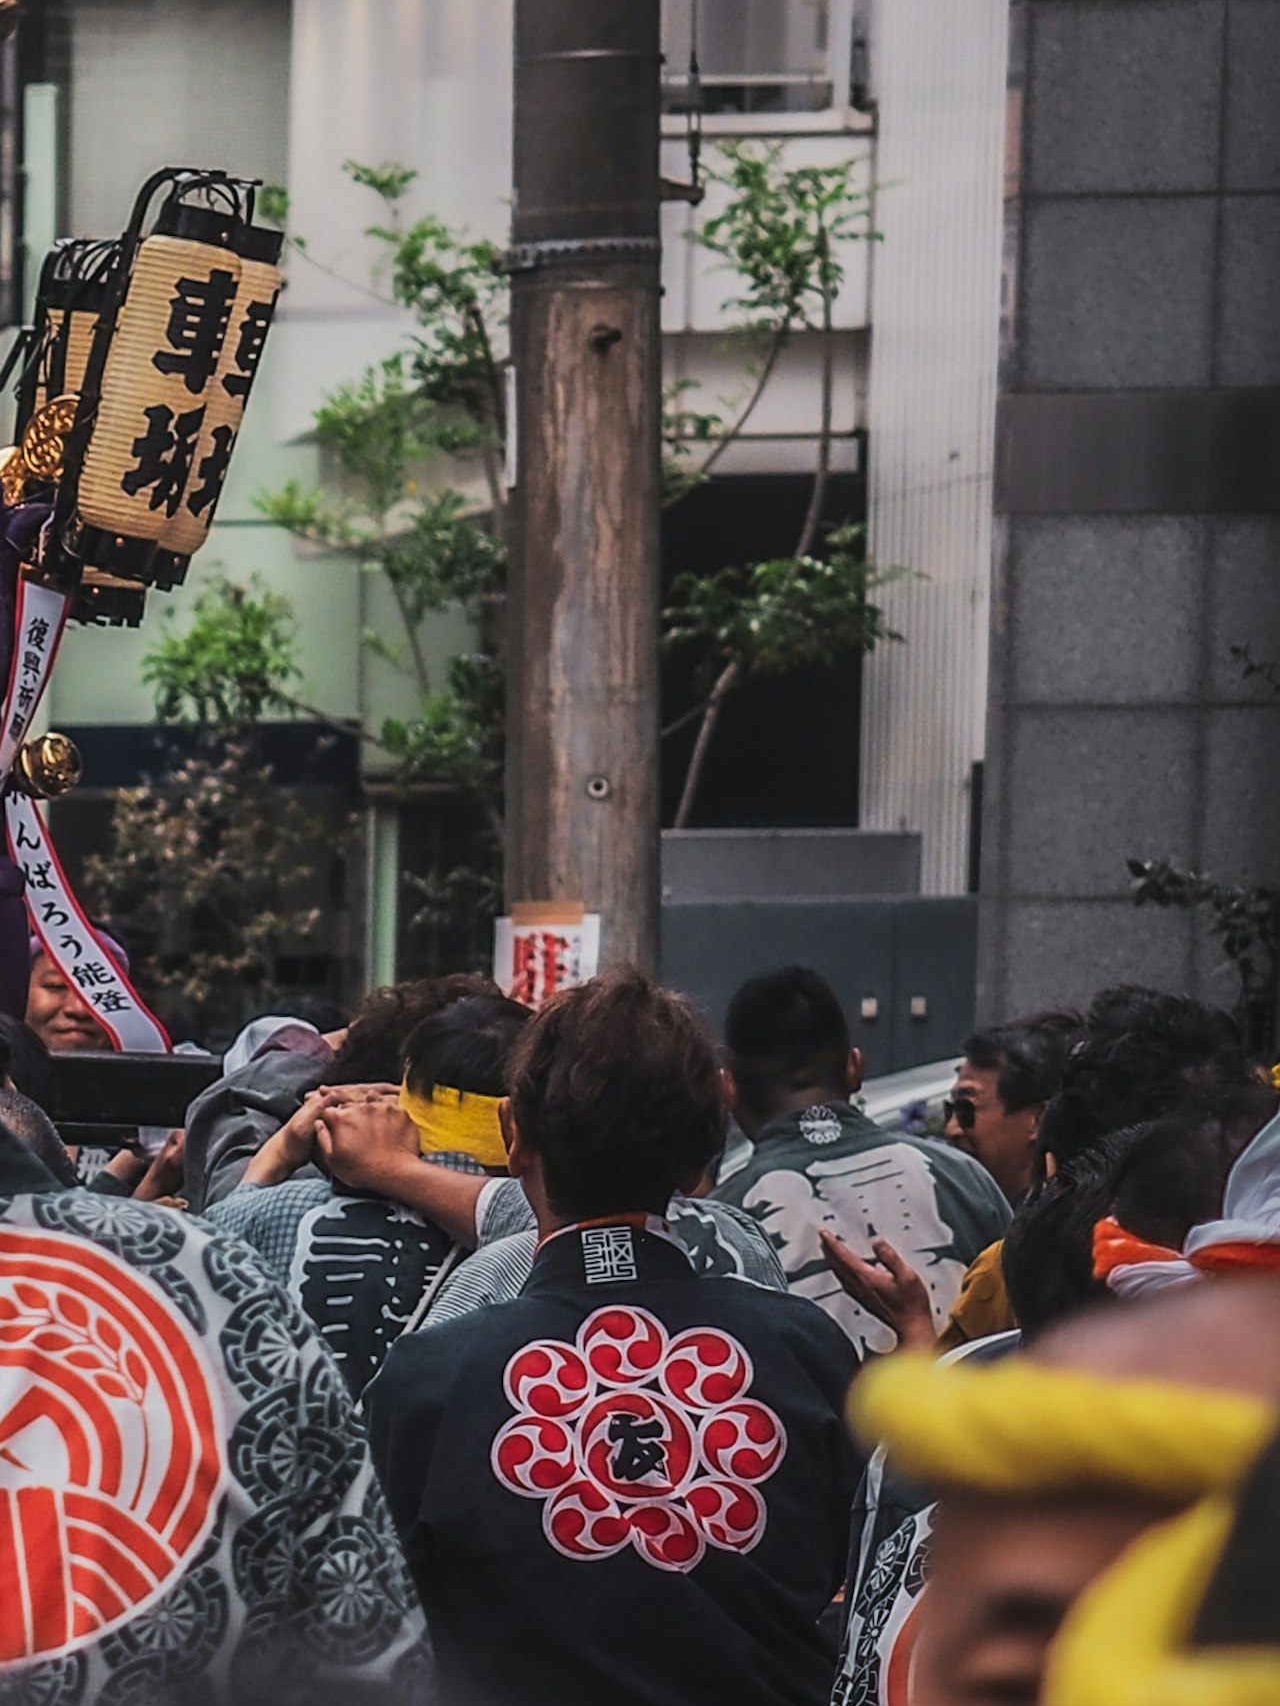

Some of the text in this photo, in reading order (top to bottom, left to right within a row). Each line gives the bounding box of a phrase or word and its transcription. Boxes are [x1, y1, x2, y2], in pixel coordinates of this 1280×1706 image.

[8, 616, 50, 742] 復興祈願
[6, 790, 133, 1014] んばろう能登
